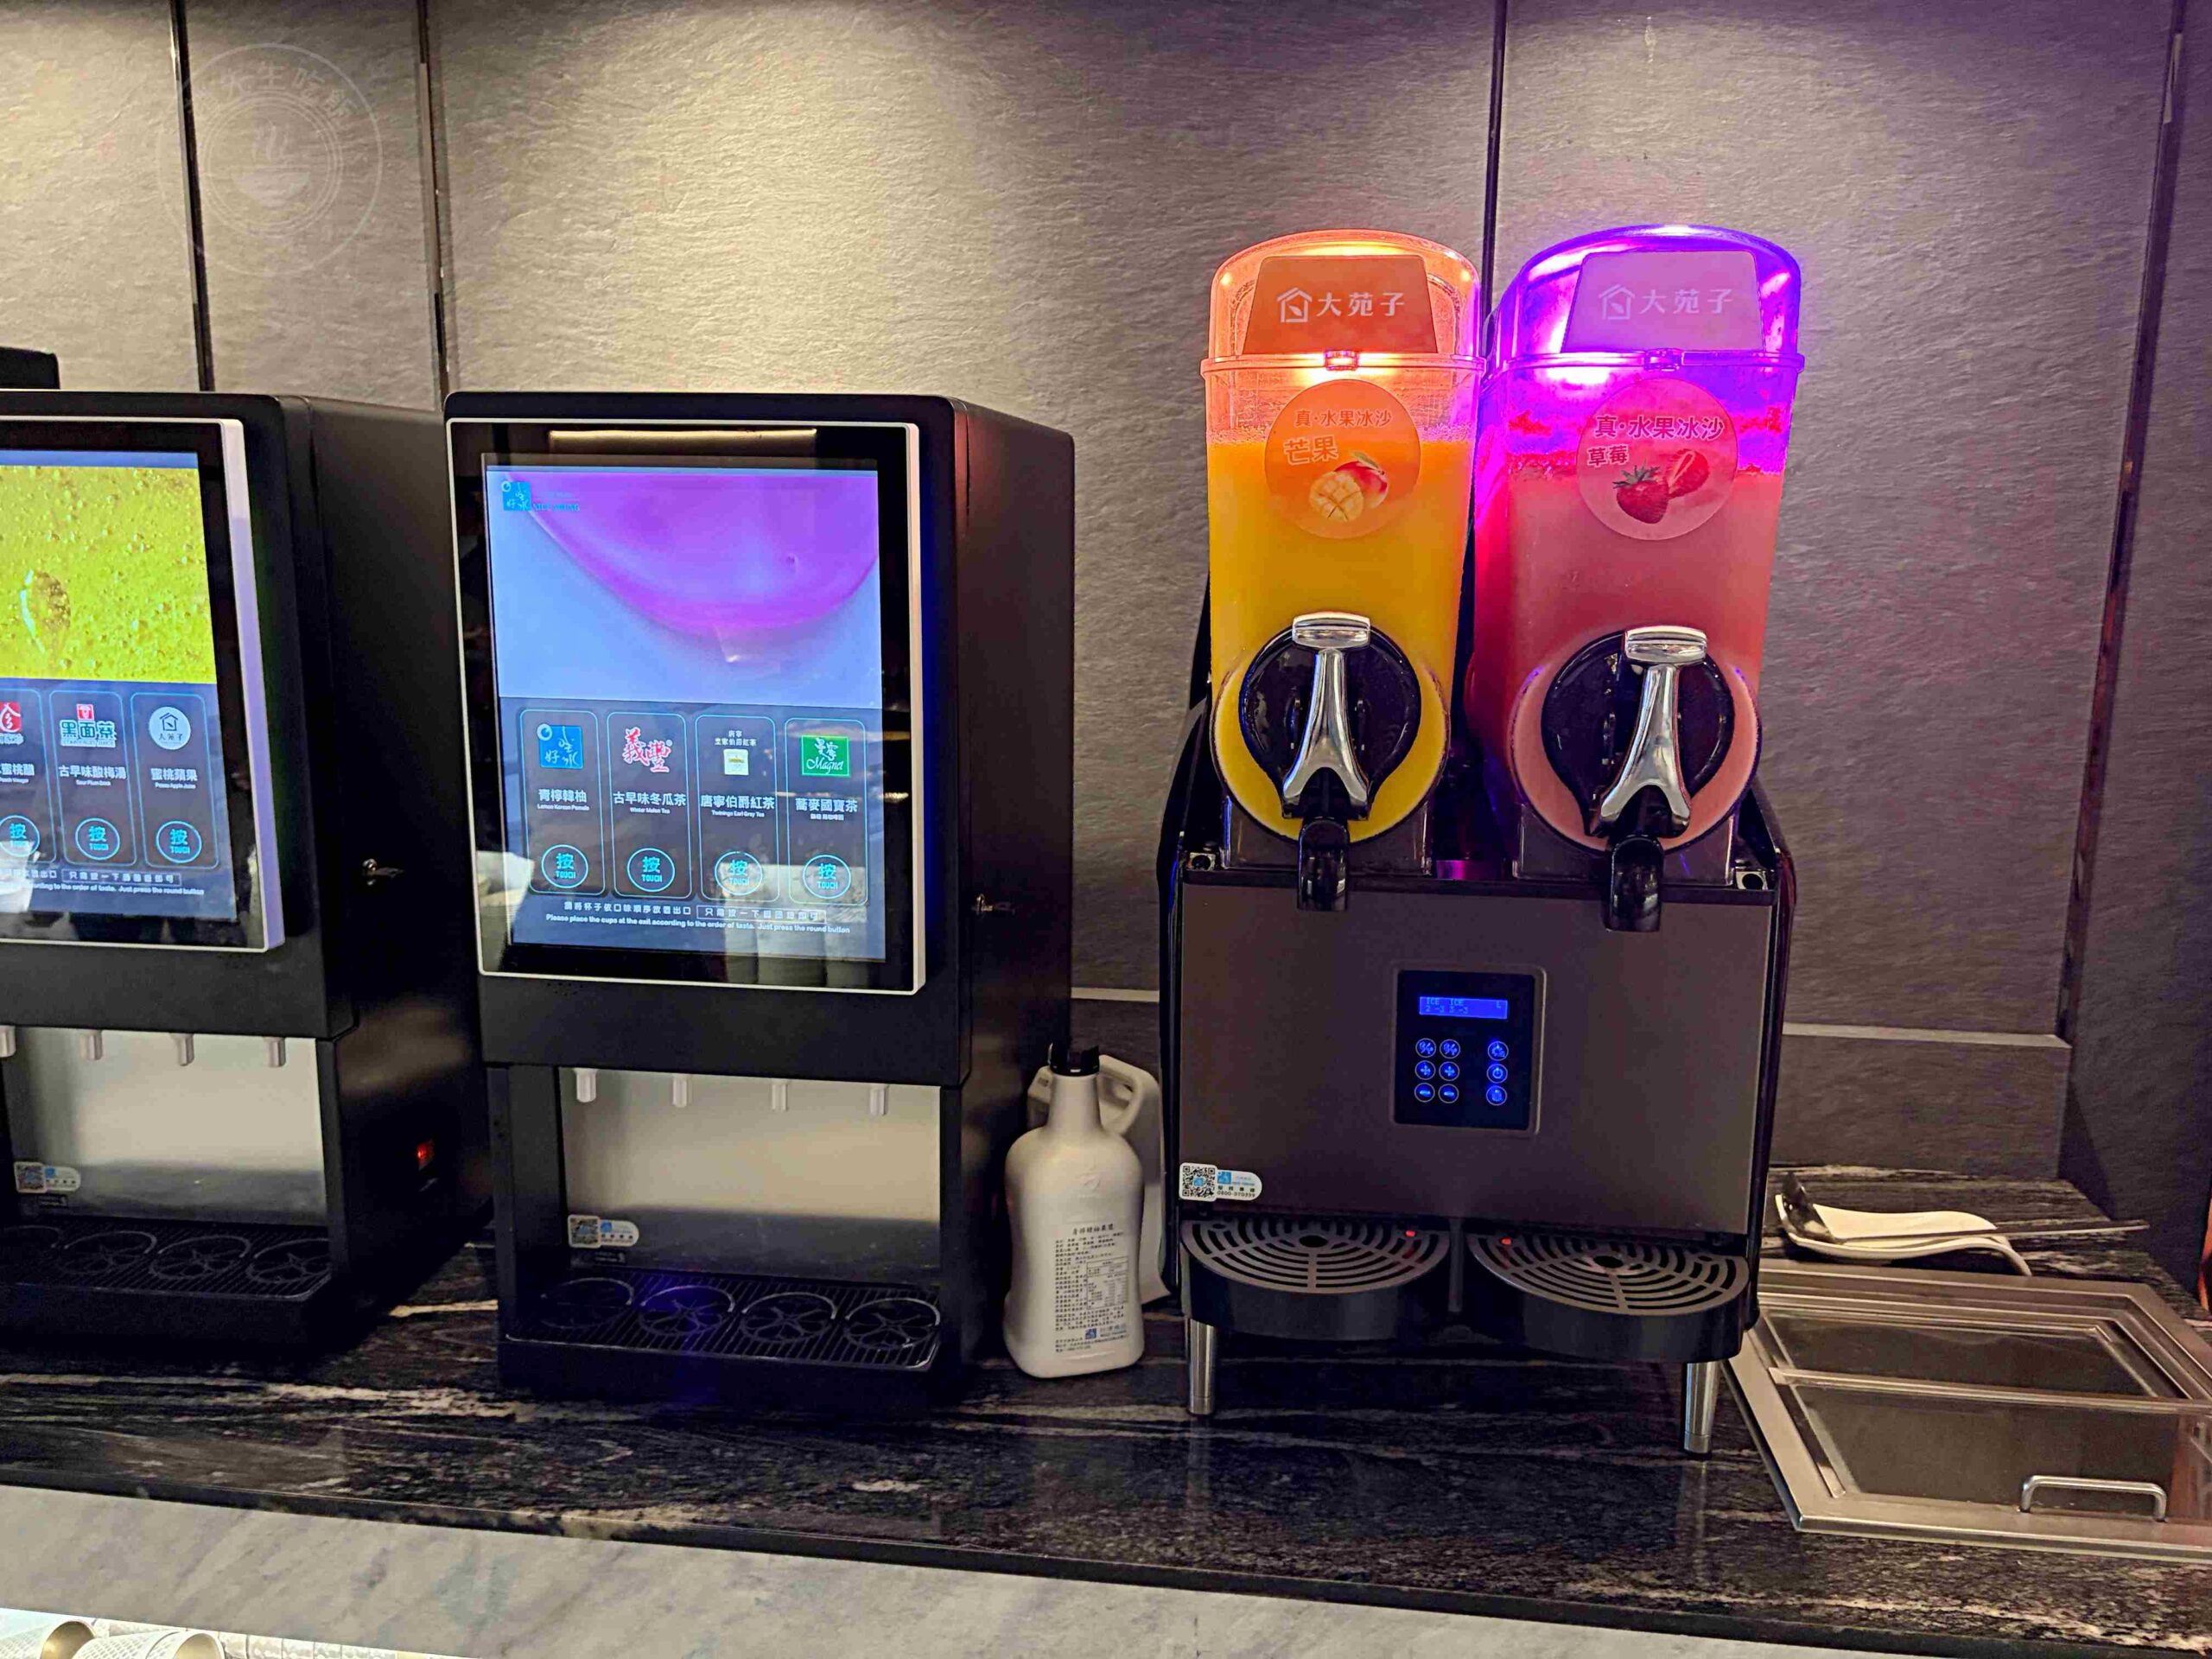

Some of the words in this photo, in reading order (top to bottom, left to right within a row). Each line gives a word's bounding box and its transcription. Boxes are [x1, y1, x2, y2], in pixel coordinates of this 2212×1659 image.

[1316, 292, 1405, 316] 大苑子
[1640, 289, 1733, 315] 大苑子
[1284, 435, 1338, 466] 芒果
[1587, 445, 1630, 467] 草莓
[59, 765, 126, 779] 古早味酸梅湯
[150, 767, 198, 781] 蜜桃蘋果
[538, 789, 587, 803] 青檸韓柚
[613, 791, 686, 807] 古早味冬瓜茶
[701, 795, 775, 810] 唐寧伯爵紅茶
[795, 798, 858, 813] 蕎麥國寶茶
[10, 823, 27, 840] 按
[88, 826, 107, 842] 按
[170, 829, 188, 846] 按
[556, 853, 575, 869] 按
[642, 856, 660, 874] 按
[728, 859, 748, 876] 按
[555, 870, 576, 879] TOUCH
[641, 874, 663, 883] TOUCH
[818, 862, 836, 880] 按
[729, 877, 750, 887] TOUCH
[817, 880, 838, 890] TOUCH
[546, 913, 569, 922] Please
[569, 914, 588, 924] place
[652, 918, 686, 928] according
